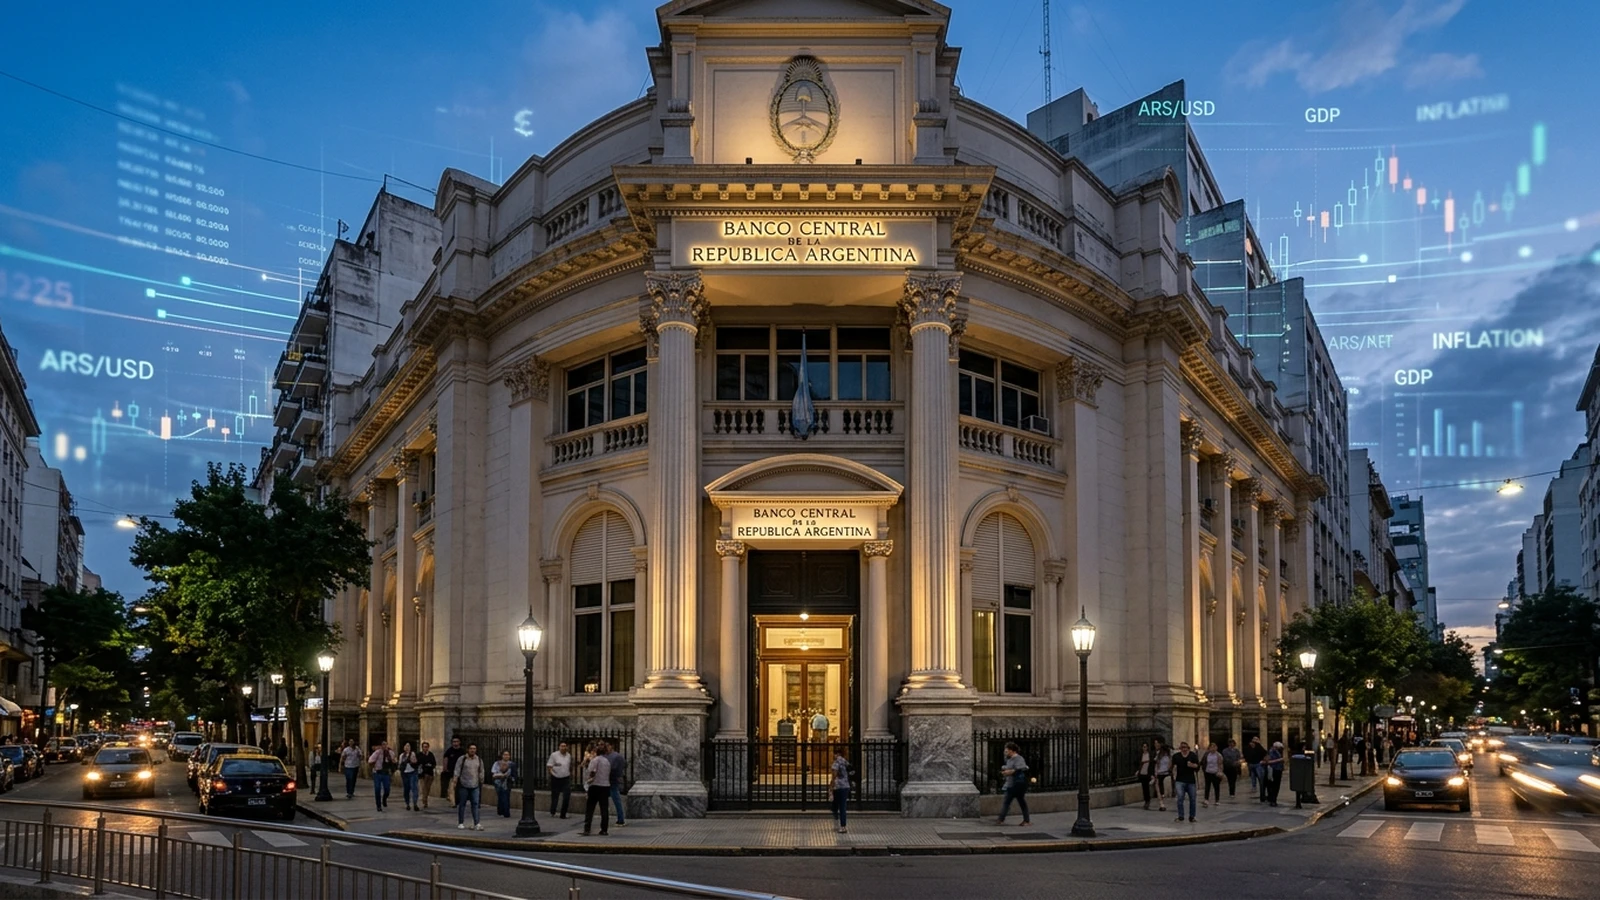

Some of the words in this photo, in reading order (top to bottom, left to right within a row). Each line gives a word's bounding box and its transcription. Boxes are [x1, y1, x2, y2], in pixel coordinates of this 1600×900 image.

[723, 221, 792, 236] BANCO
[799, 221, 886, 236] CENTRAL
[807, 237, 821, 246] LA
[692, 247, 797, 262] REPUBLICA
[805, 247, 917, 262] ARGENTINA
[753, 508, 796, 519] BANCO
[800, 508, 856, 519] CENTRAL
[737, 526, 801, 537] REPUBLICA
[804, 526, 872, 537] ARGENTINA
